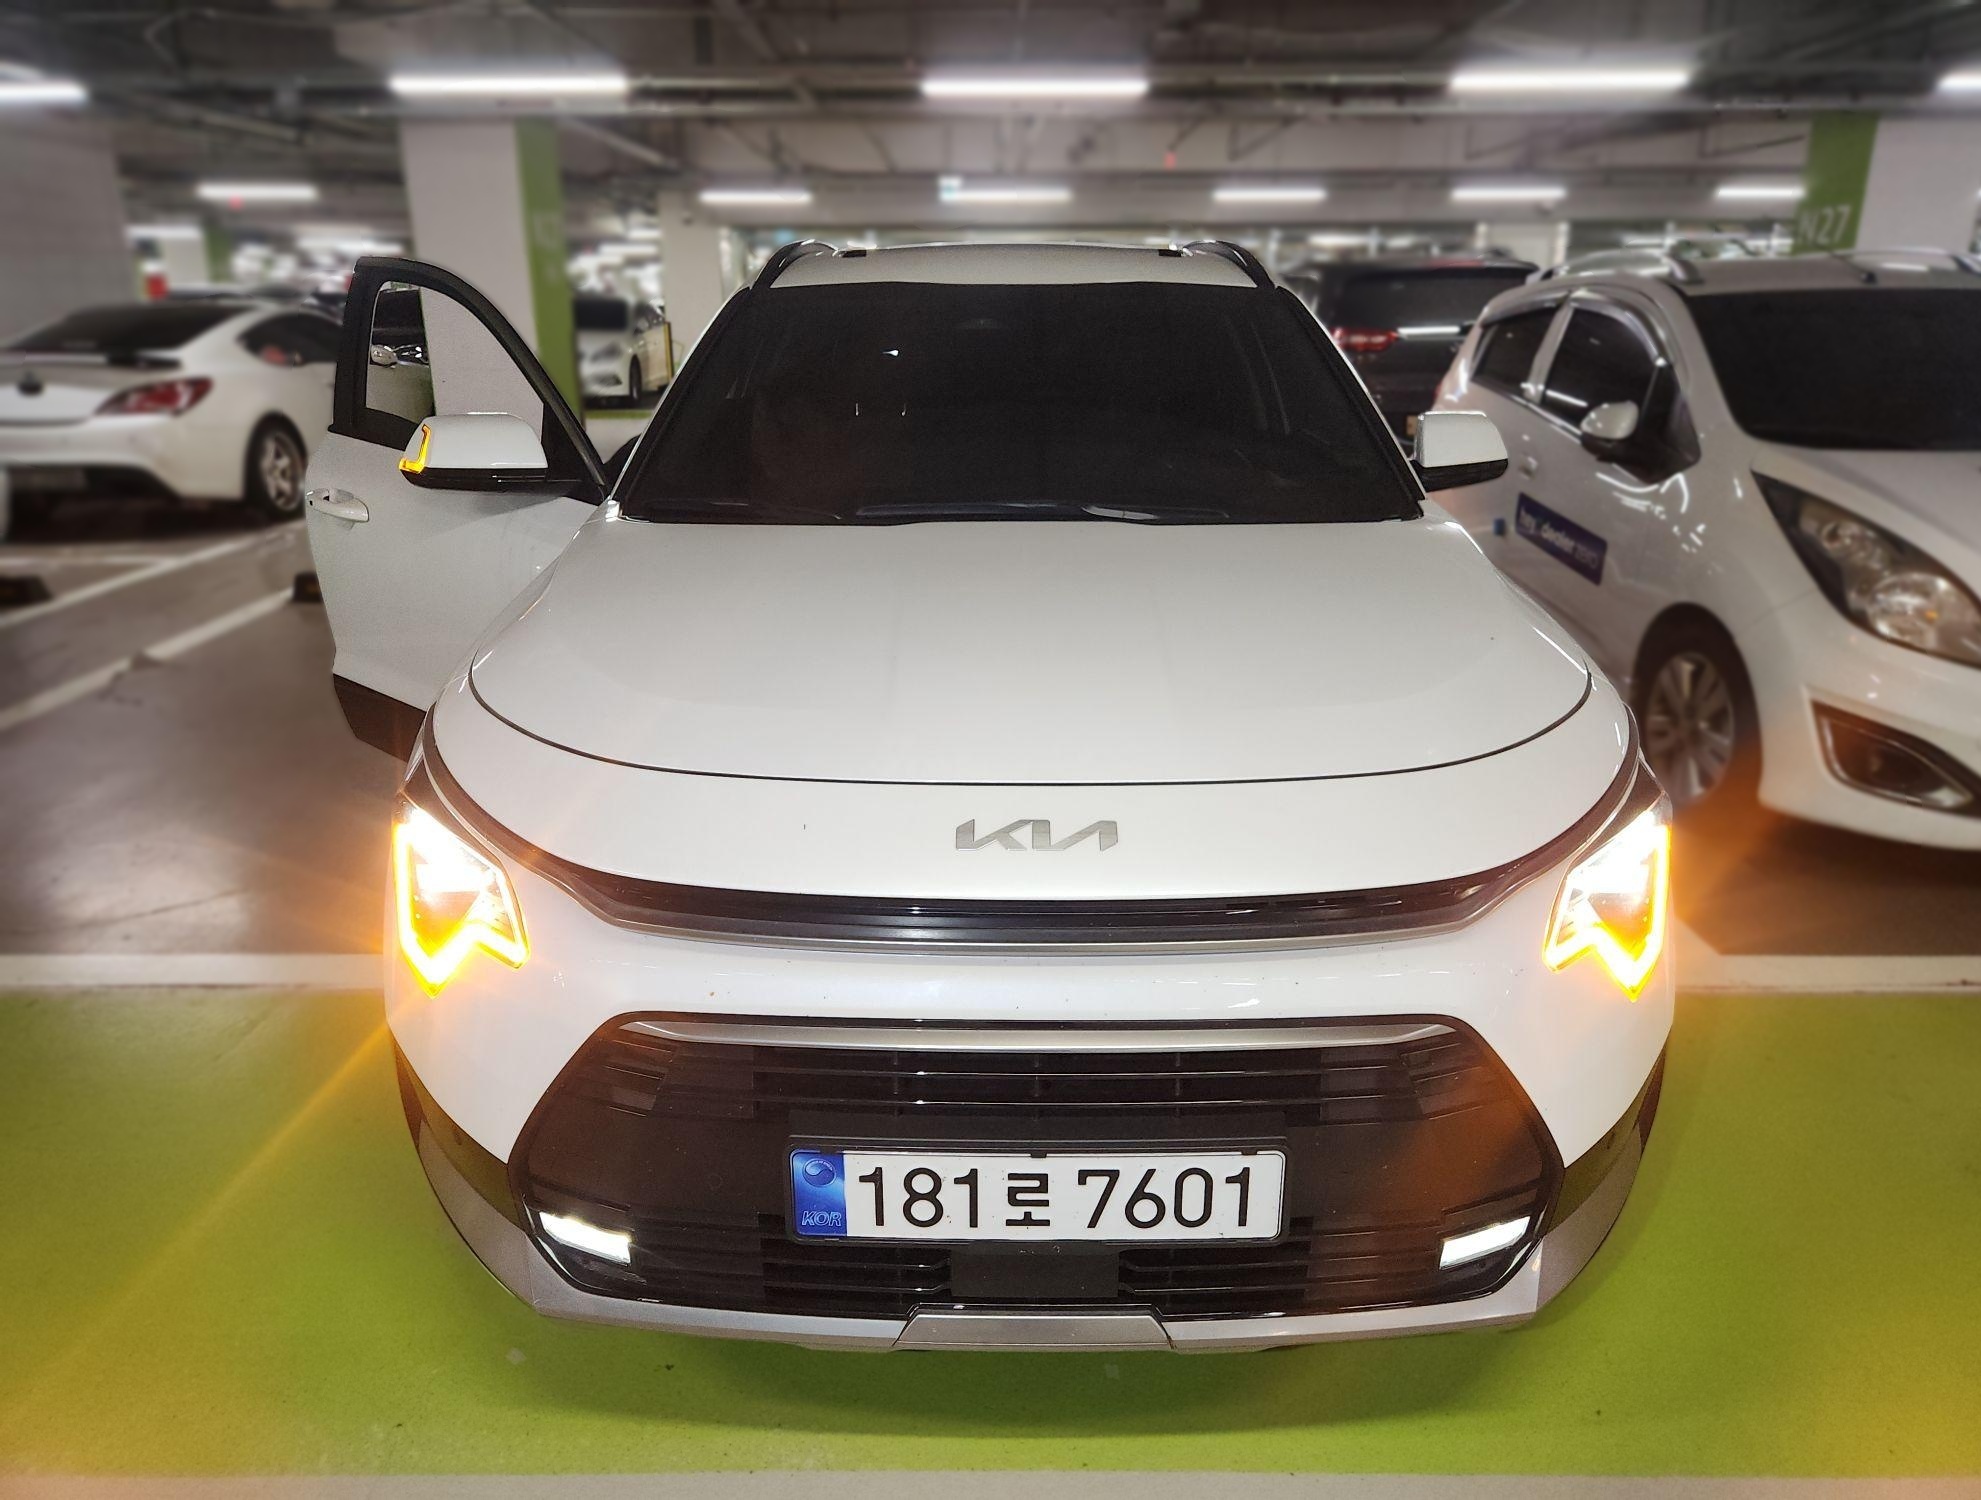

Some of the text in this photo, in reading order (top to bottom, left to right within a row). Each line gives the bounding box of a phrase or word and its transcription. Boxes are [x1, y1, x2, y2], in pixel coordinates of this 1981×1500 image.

[1797, 204, 1852, 246] N27
[955, 818, 1119, 851] KIA
[858, 1165, 1251, 1229] 181로 7601
[801, 1210, 842, 1227] KOR
